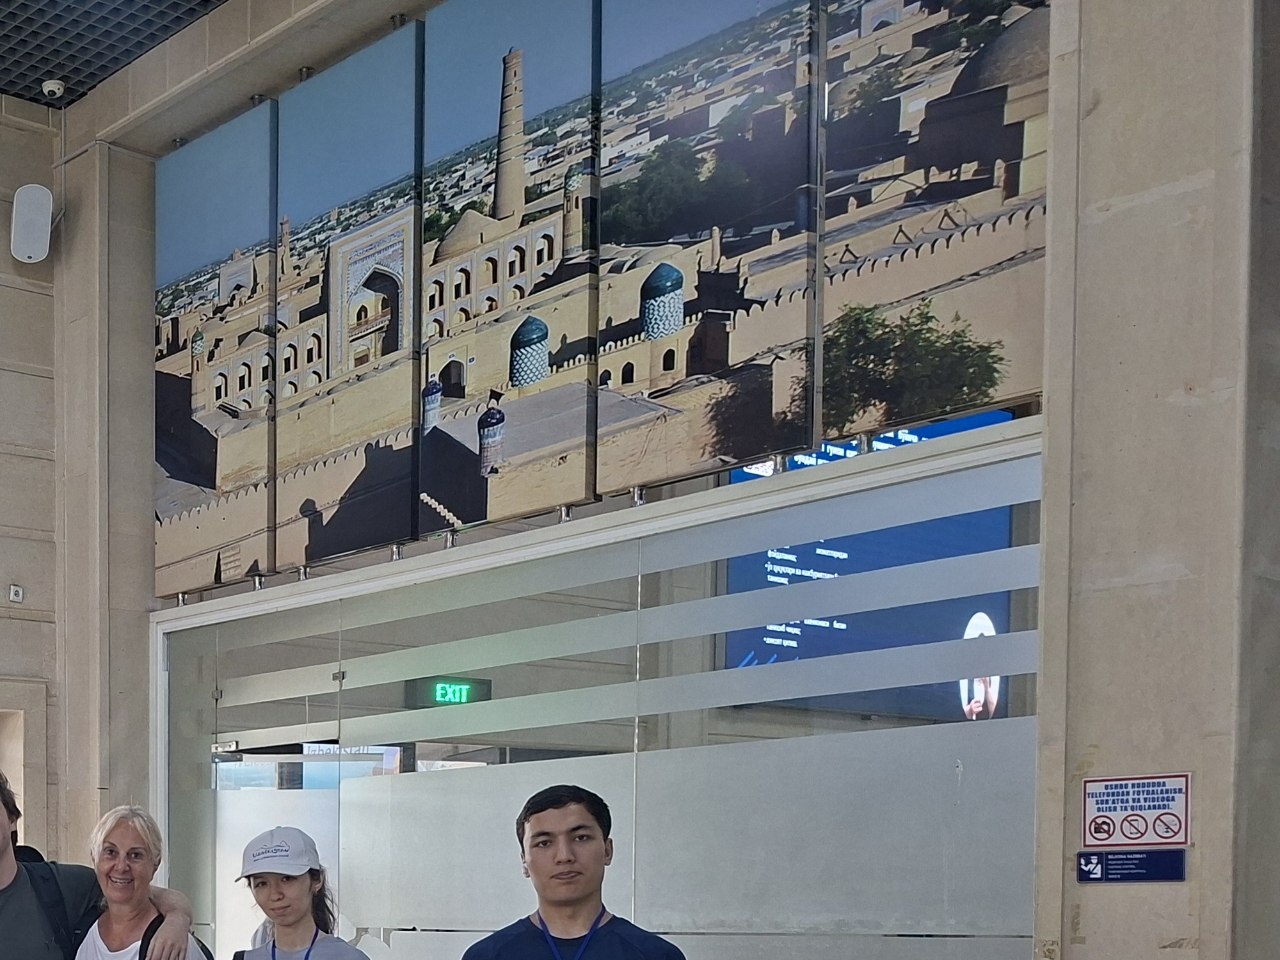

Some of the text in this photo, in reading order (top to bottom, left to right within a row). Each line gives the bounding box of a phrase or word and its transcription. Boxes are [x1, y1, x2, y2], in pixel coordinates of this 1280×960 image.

[435, 683, 471, 703] EXIT
[1087, 790, 1130, 799] TELEFONDAN
[1143, 796, 1176, 804] VIDEOGA
[1096, 805, 1117, 813] OLISH
